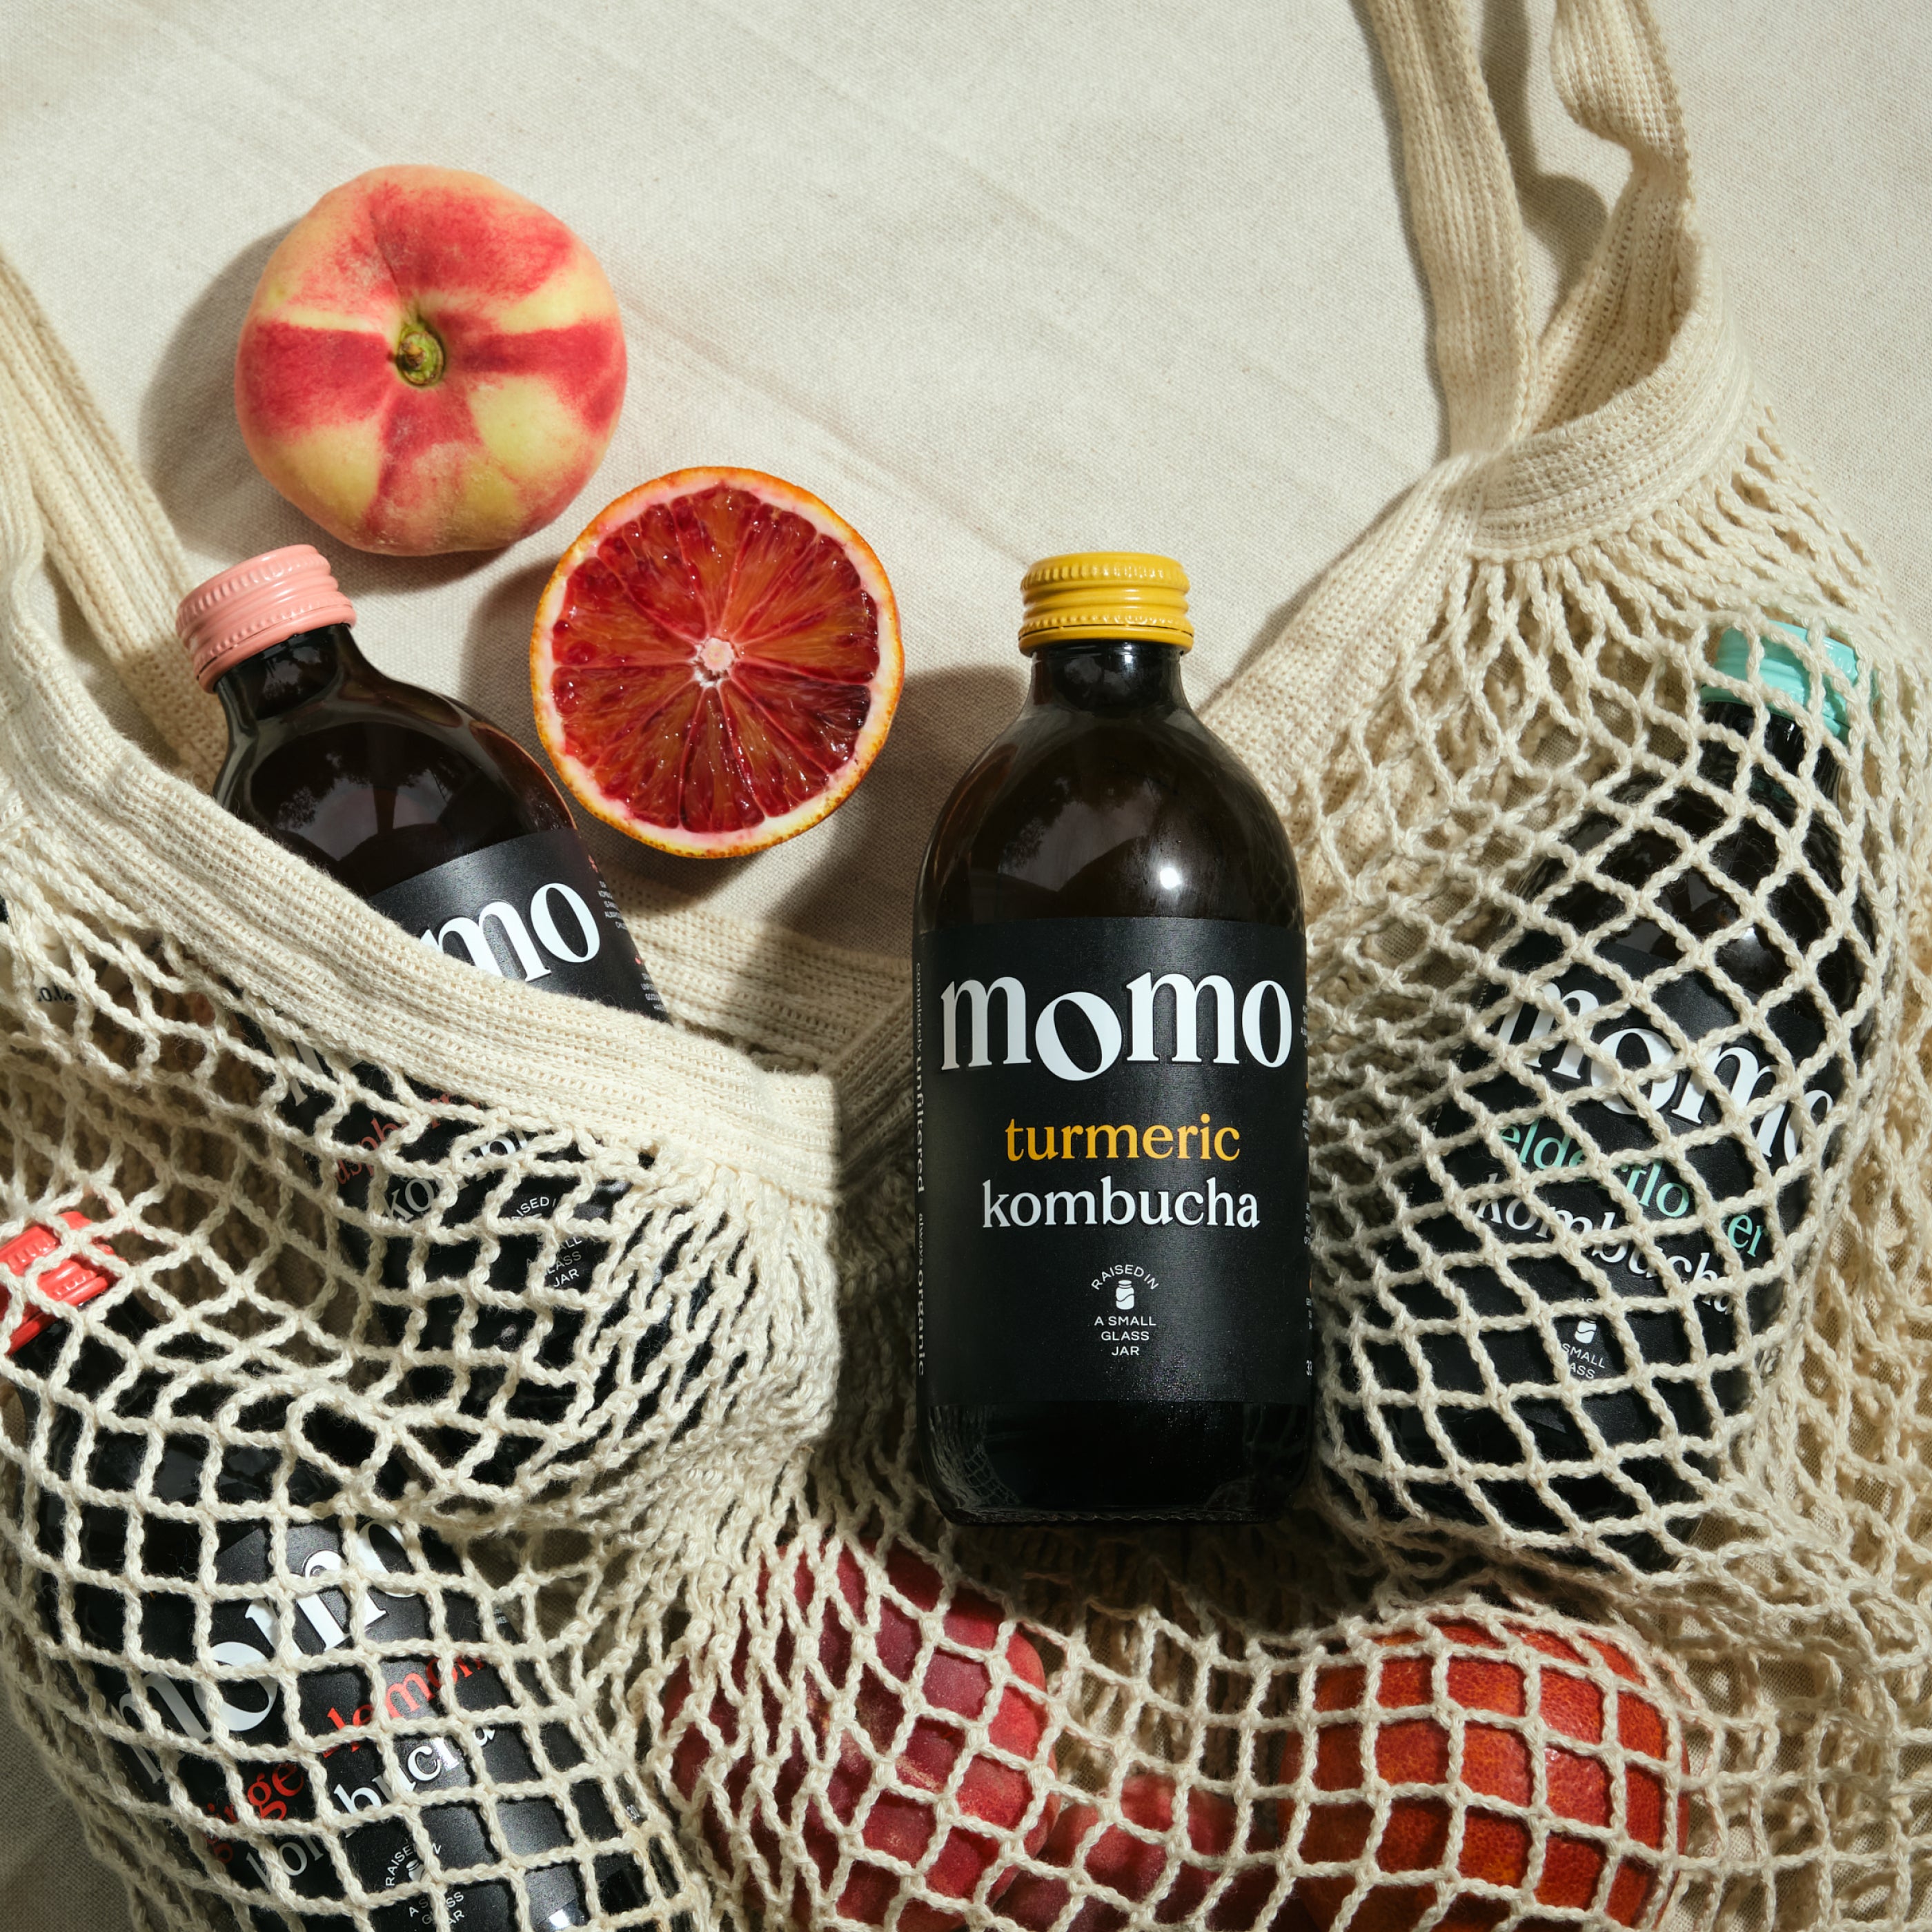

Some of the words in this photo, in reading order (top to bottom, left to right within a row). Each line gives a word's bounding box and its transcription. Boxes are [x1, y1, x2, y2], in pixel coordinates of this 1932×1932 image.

[940, 972, 1294, 1081] momo
[1497, 982, 1834, 1165] momo
[1005, 1114, 1241, 1161] turmeric
[982, 1176, 1261, 1228] kombucha
[544, 1250, 582, 1275] LASS
[553, 1268, 580, 1288] JAR
[1091, 1264, 1145, 1290] RAISED
[1143, 1274, 1160, 1290] IN
[918, 1270, 926, 1376] organic
[1094, 1316, 1105, 1326] A
[1108, 1316, 1157, 1326] SMALL
[1101, 1330, 1150, 1341] GLASS
[1111, 1346, 1141, 1356] JAR
[1561, 1343, 1606, 1369] SMALL
[1569, 1362, 1596, 1379] ASS
[110, 1519, 417, 1784] momo
[385, 1838, 414, 1886] RAISE
